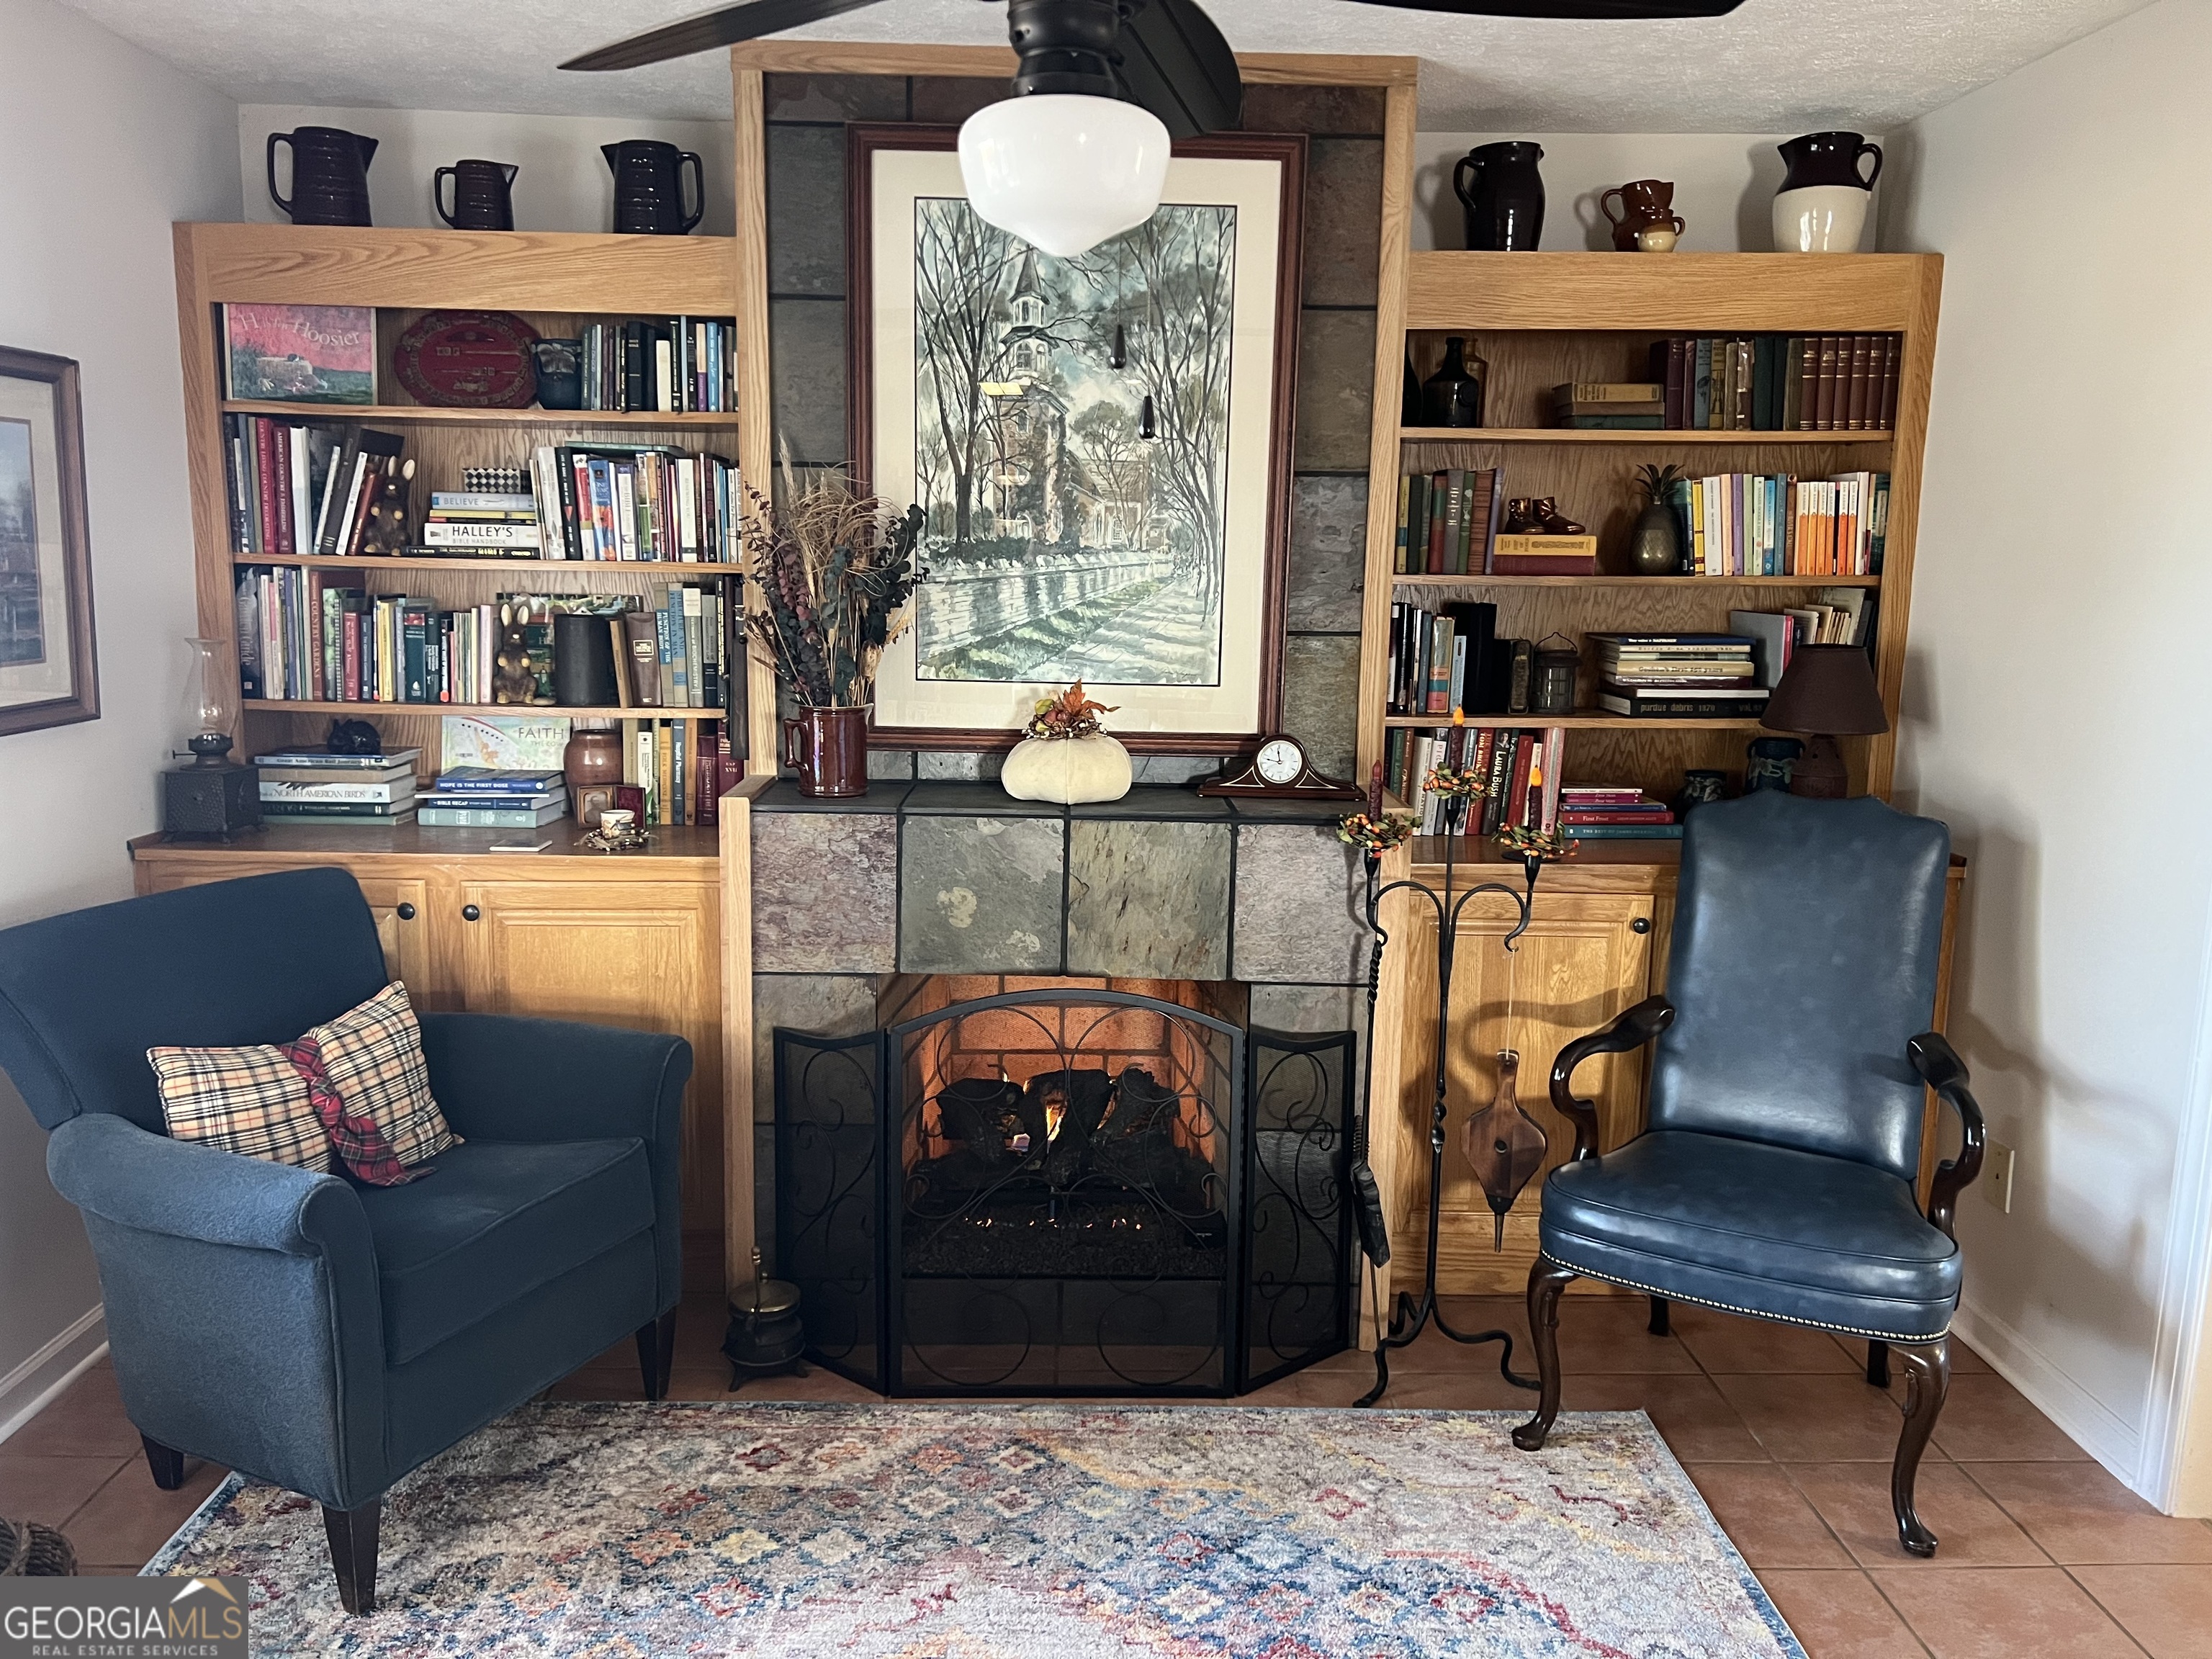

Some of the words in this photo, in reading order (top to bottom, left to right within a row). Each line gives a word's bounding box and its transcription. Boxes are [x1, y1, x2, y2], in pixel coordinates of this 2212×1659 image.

[238, 312, 259, 331] H
[293, 321, 359, 346] Hoosier
[451, 526, 513, 537] HALLEY'S
[311, 601, 320, 638] COUNTRY
[675, 592, 685, 632] STRUCTURE
[240, 636, 255, 665] Guide
[664, 642, 670, 650] OF
[313, 641, 321, 678] GARDENS
[1640, 703, 1667, 713] purdue
[518, 727, 564, 739] FAITH
[1475, 750, 1484, 770] BROK
[1493, 750, 1507, 776] LAURA
[271, 788, 303, 797] NORTH
[305, 789, 343, 798] AMERICAN
[1490, 776, 1503, 798] BUSH
